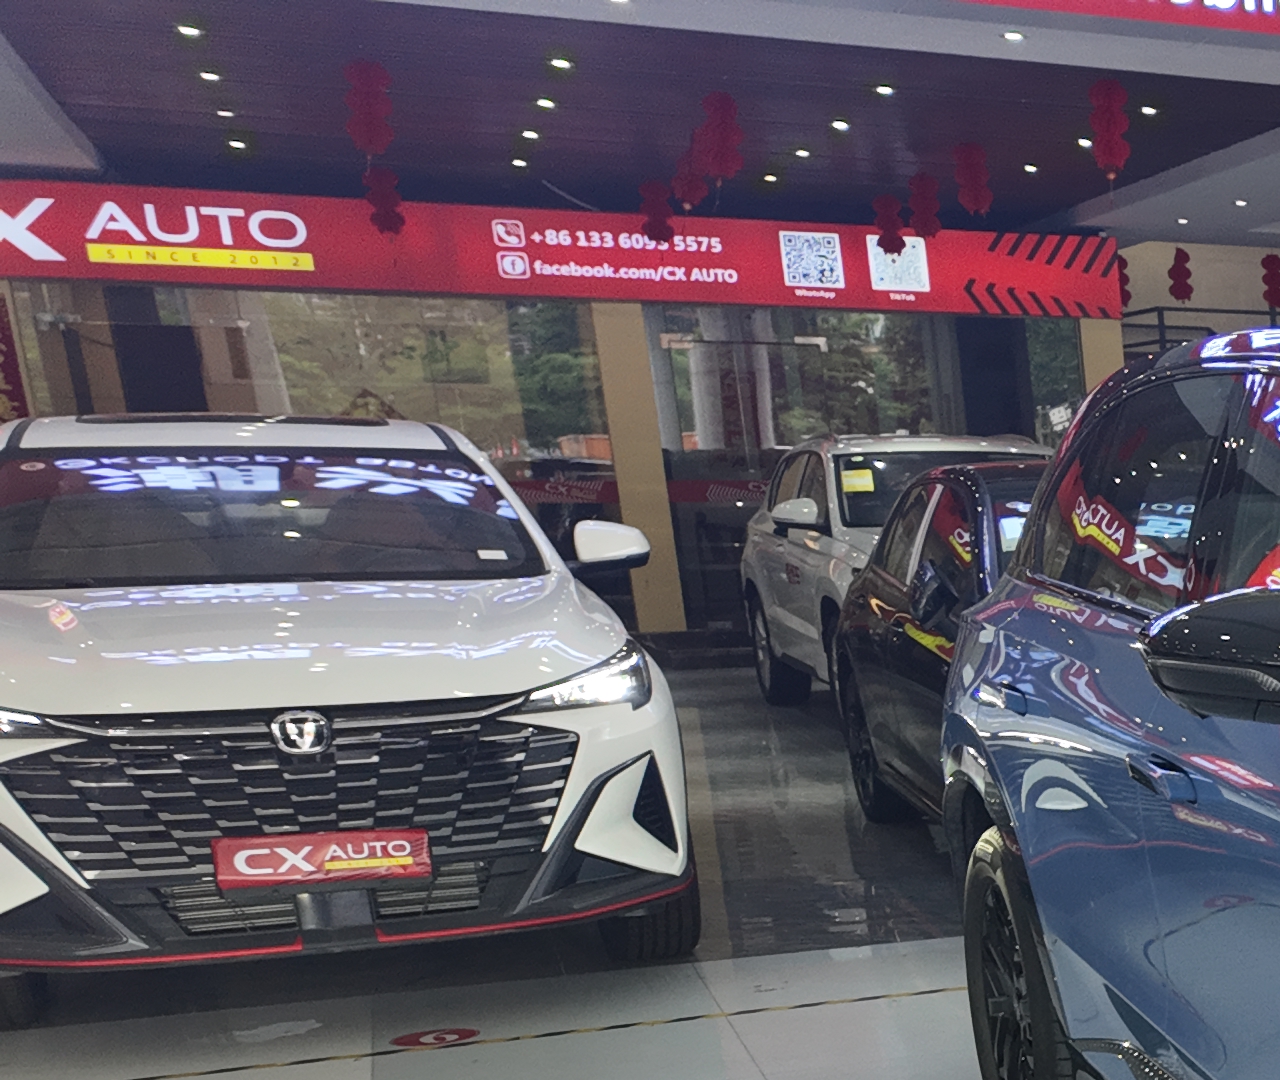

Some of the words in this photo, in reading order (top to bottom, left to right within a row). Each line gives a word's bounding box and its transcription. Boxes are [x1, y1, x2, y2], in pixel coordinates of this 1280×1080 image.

[85, 201, 308, 249] AUTO
[530, 229, 572, 246] +86
[576, 231, 615, 248] 133
[673, 236, 723, 253] 5575
[105, 249, 201, 263] SINCE
[228, 253, 301, 267] 2012
[533, 259, 687, 282] facebook.com/CX
[690, 267, 738, 284] AUTO
[233, 845, 317, 875] CX
[325, 840, 411, 861] AUTO
